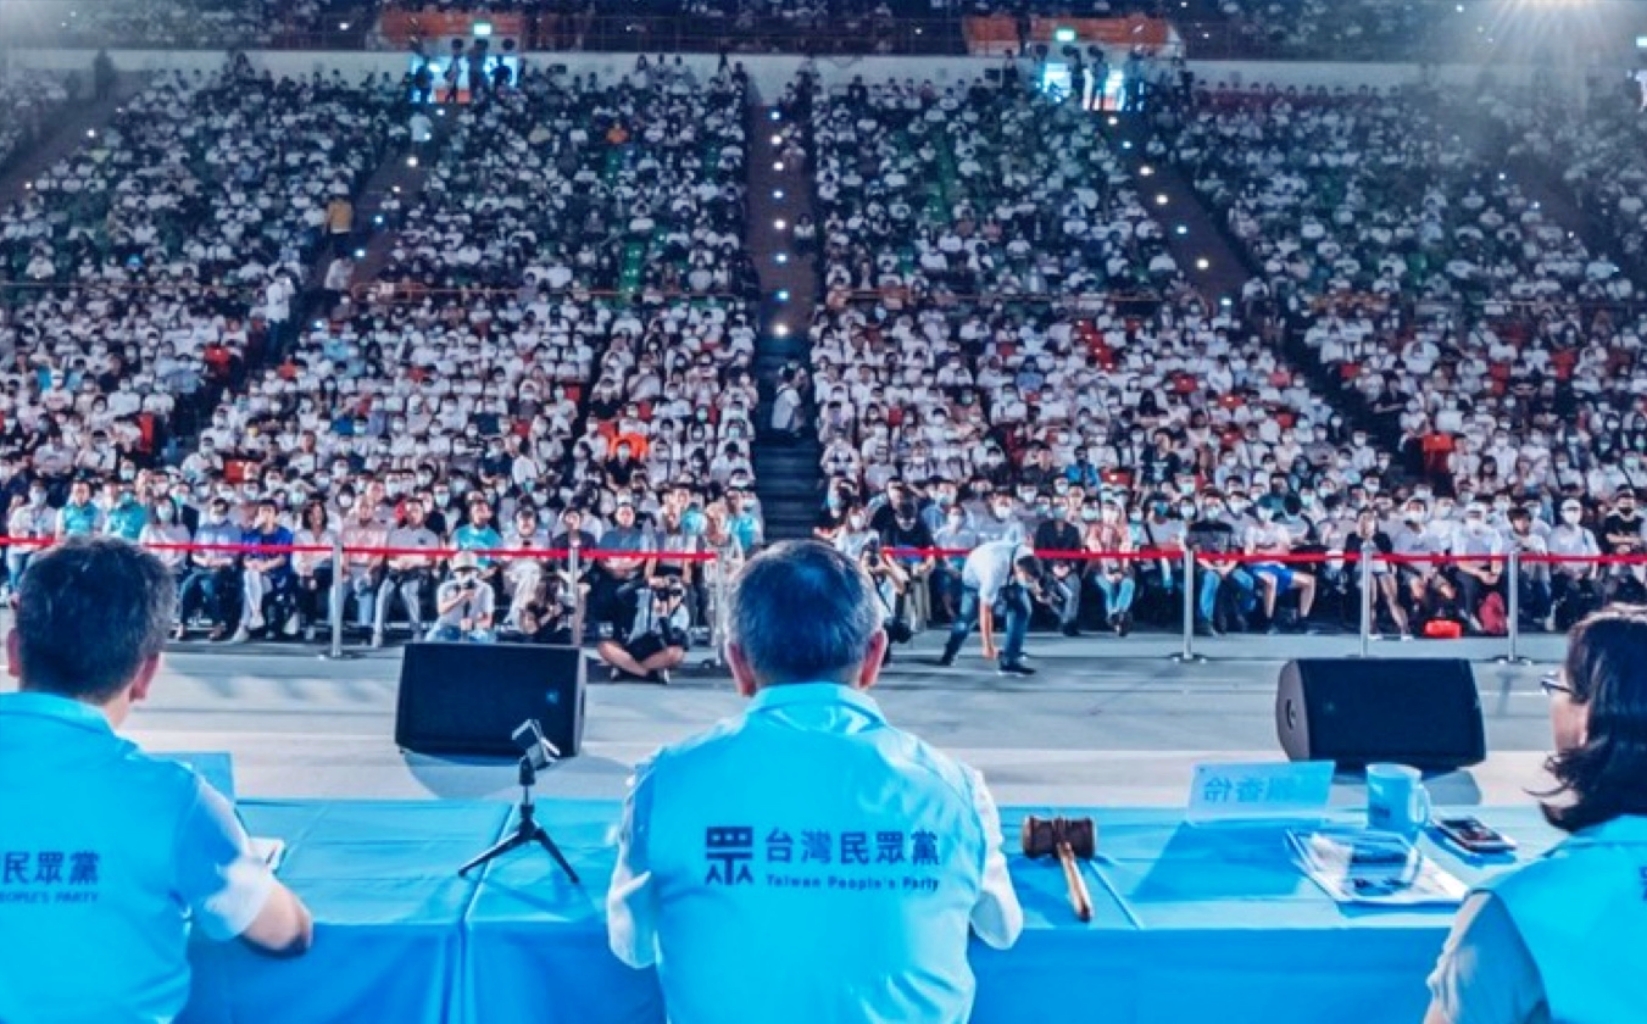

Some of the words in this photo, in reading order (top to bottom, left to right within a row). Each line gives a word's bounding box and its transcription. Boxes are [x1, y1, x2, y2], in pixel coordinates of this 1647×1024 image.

[765, 828, 940, 864] 台灣民眾黨
[902, 876, 940, 892] Party
[55, 891, 98, 902] PARTY
